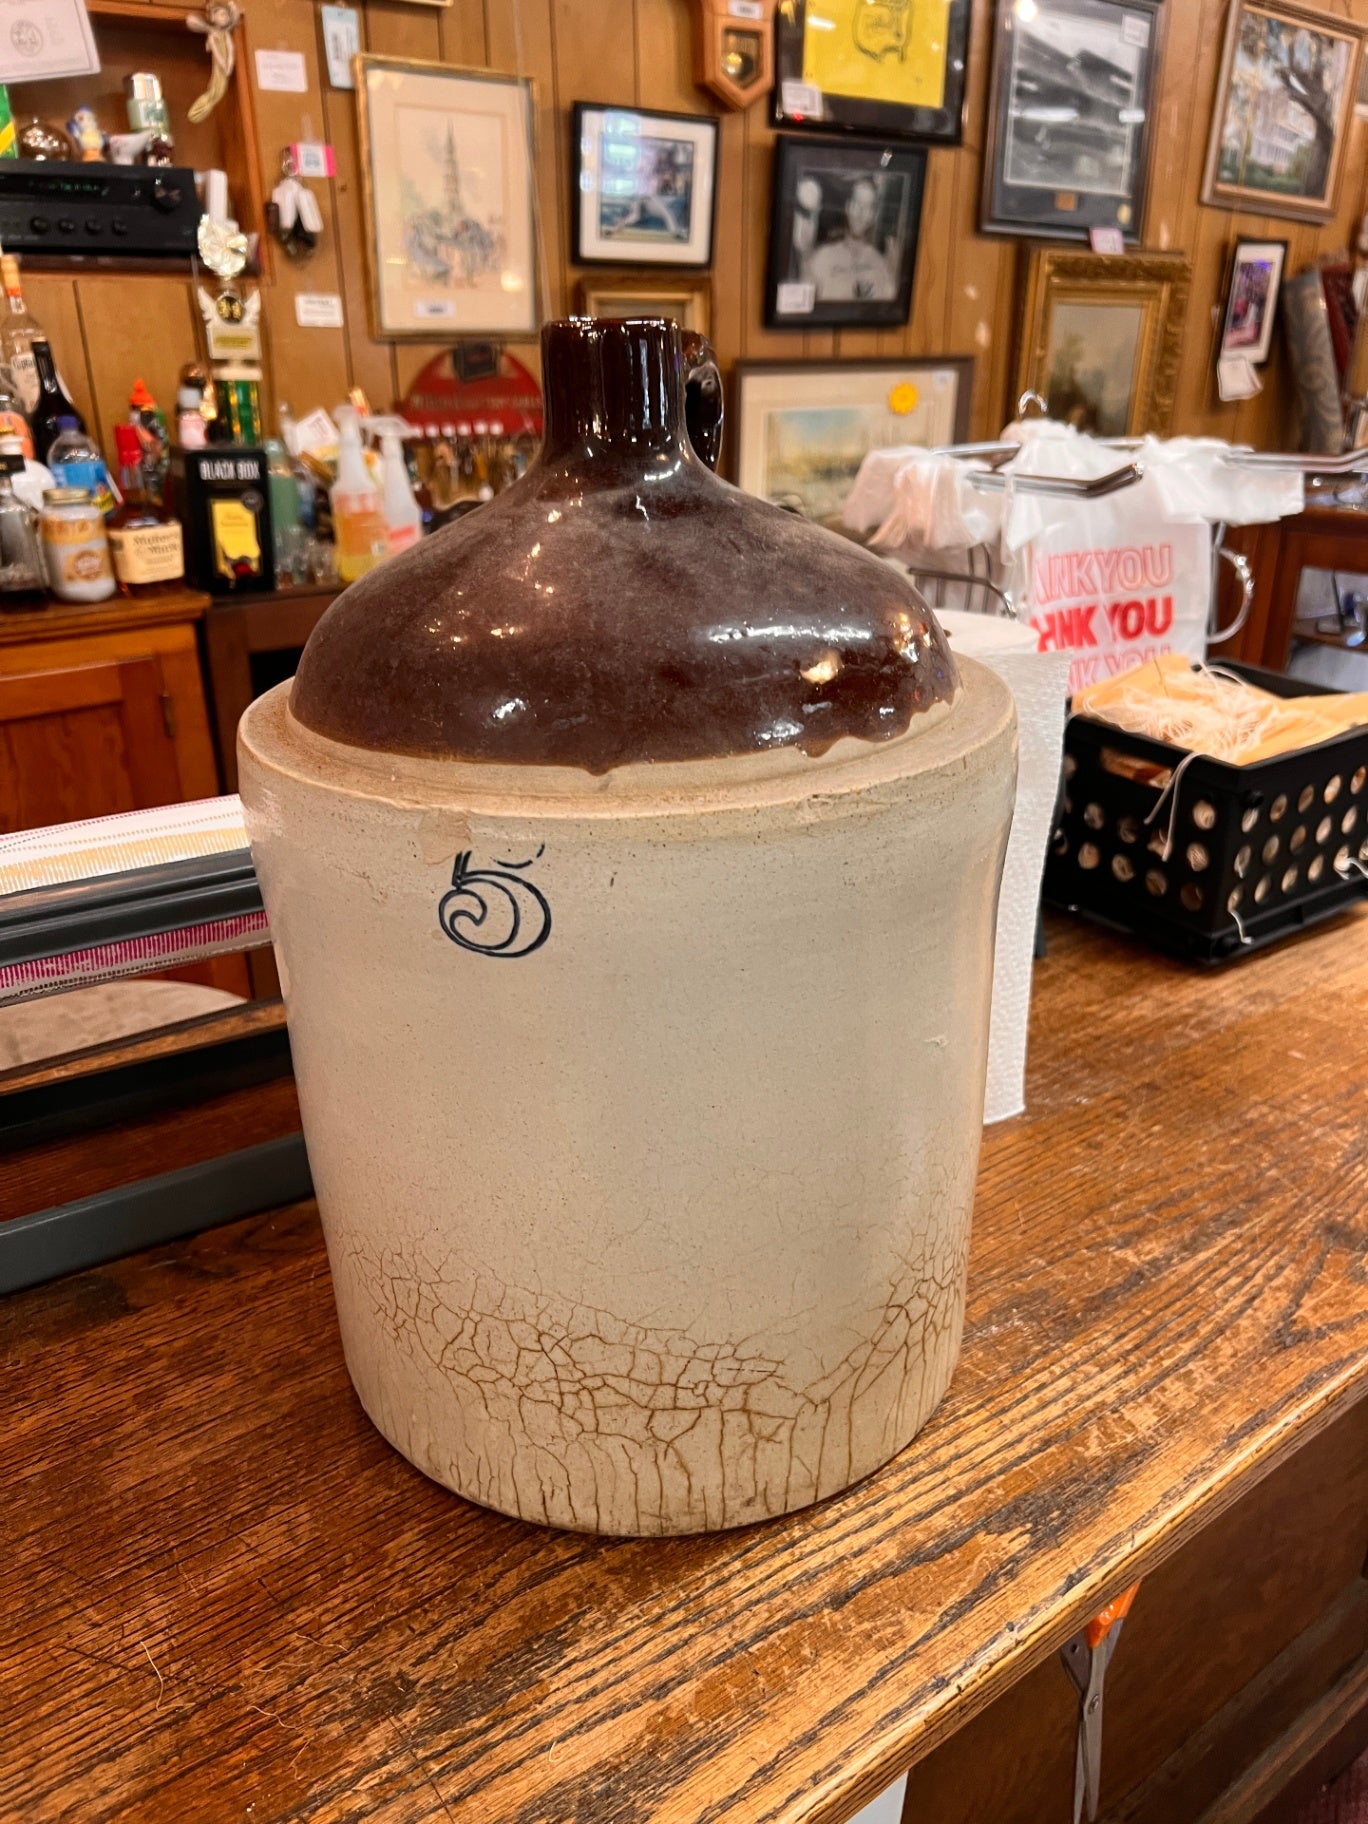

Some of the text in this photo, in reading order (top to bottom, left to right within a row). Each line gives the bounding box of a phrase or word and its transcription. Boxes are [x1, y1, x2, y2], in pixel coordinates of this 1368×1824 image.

[200, 460, 260, 480] BLACK BOX
[1097, 544, 1173, 593] YOU
[1104, 597, 1174, 642] YOU
[439, 843, 551, 958] 5
